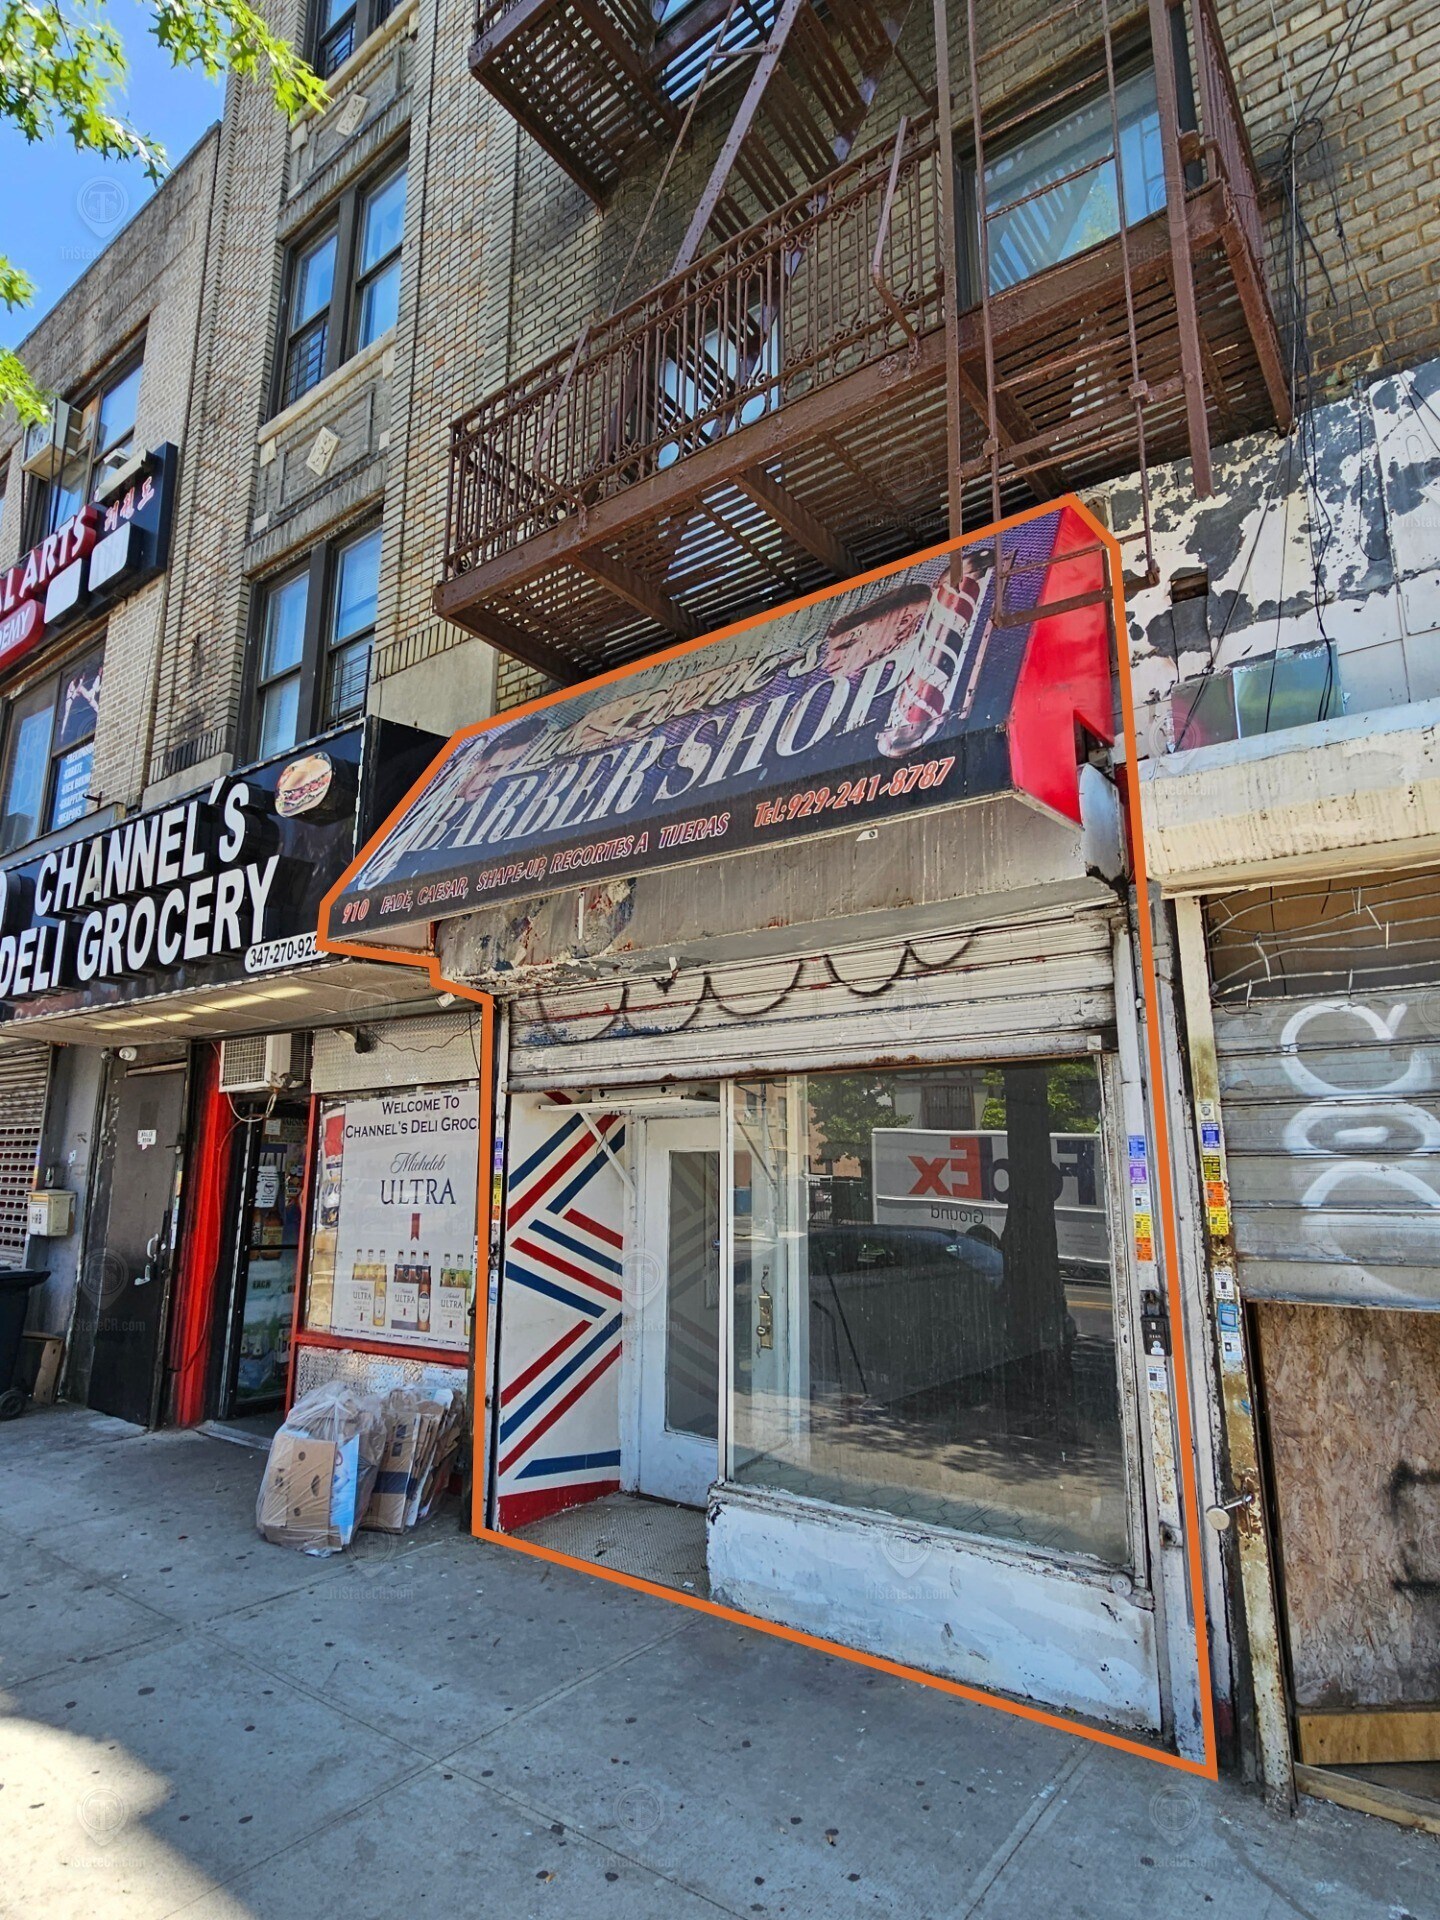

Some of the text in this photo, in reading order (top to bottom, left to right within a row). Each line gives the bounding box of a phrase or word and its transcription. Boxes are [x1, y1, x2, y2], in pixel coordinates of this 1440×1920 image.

[19, 504, 86, 599] ARTS
[404, 638, 917, 852] BARBER SHOP
[35, 776, 250, 917] CHANNEL'S
[342, 898, 370, 924] 910
[549, 835, 635, 873] RECORTES
[633, 832, 649, 853] A
[658, 813, 731, 850] TIJERAS
[0, 920, 66, 999] DELI
[77, 854, 280, 982] GROCERY
[381, 1098, 441, 1115] WELCOME
[345, 1116, 479, 1139] CHANNEL'S DELI GROC
[390, 1151, 447, 1174] Michelob
[380, 1177, 457, 1205] ULTRA
[252, 1280, 271, 1289] EACH
[352, 1291, 372, 1301] ULTRA
[394, 1294, 416, 1304] ULTRA
[440, 1299, 463, 1309] ULTRA
